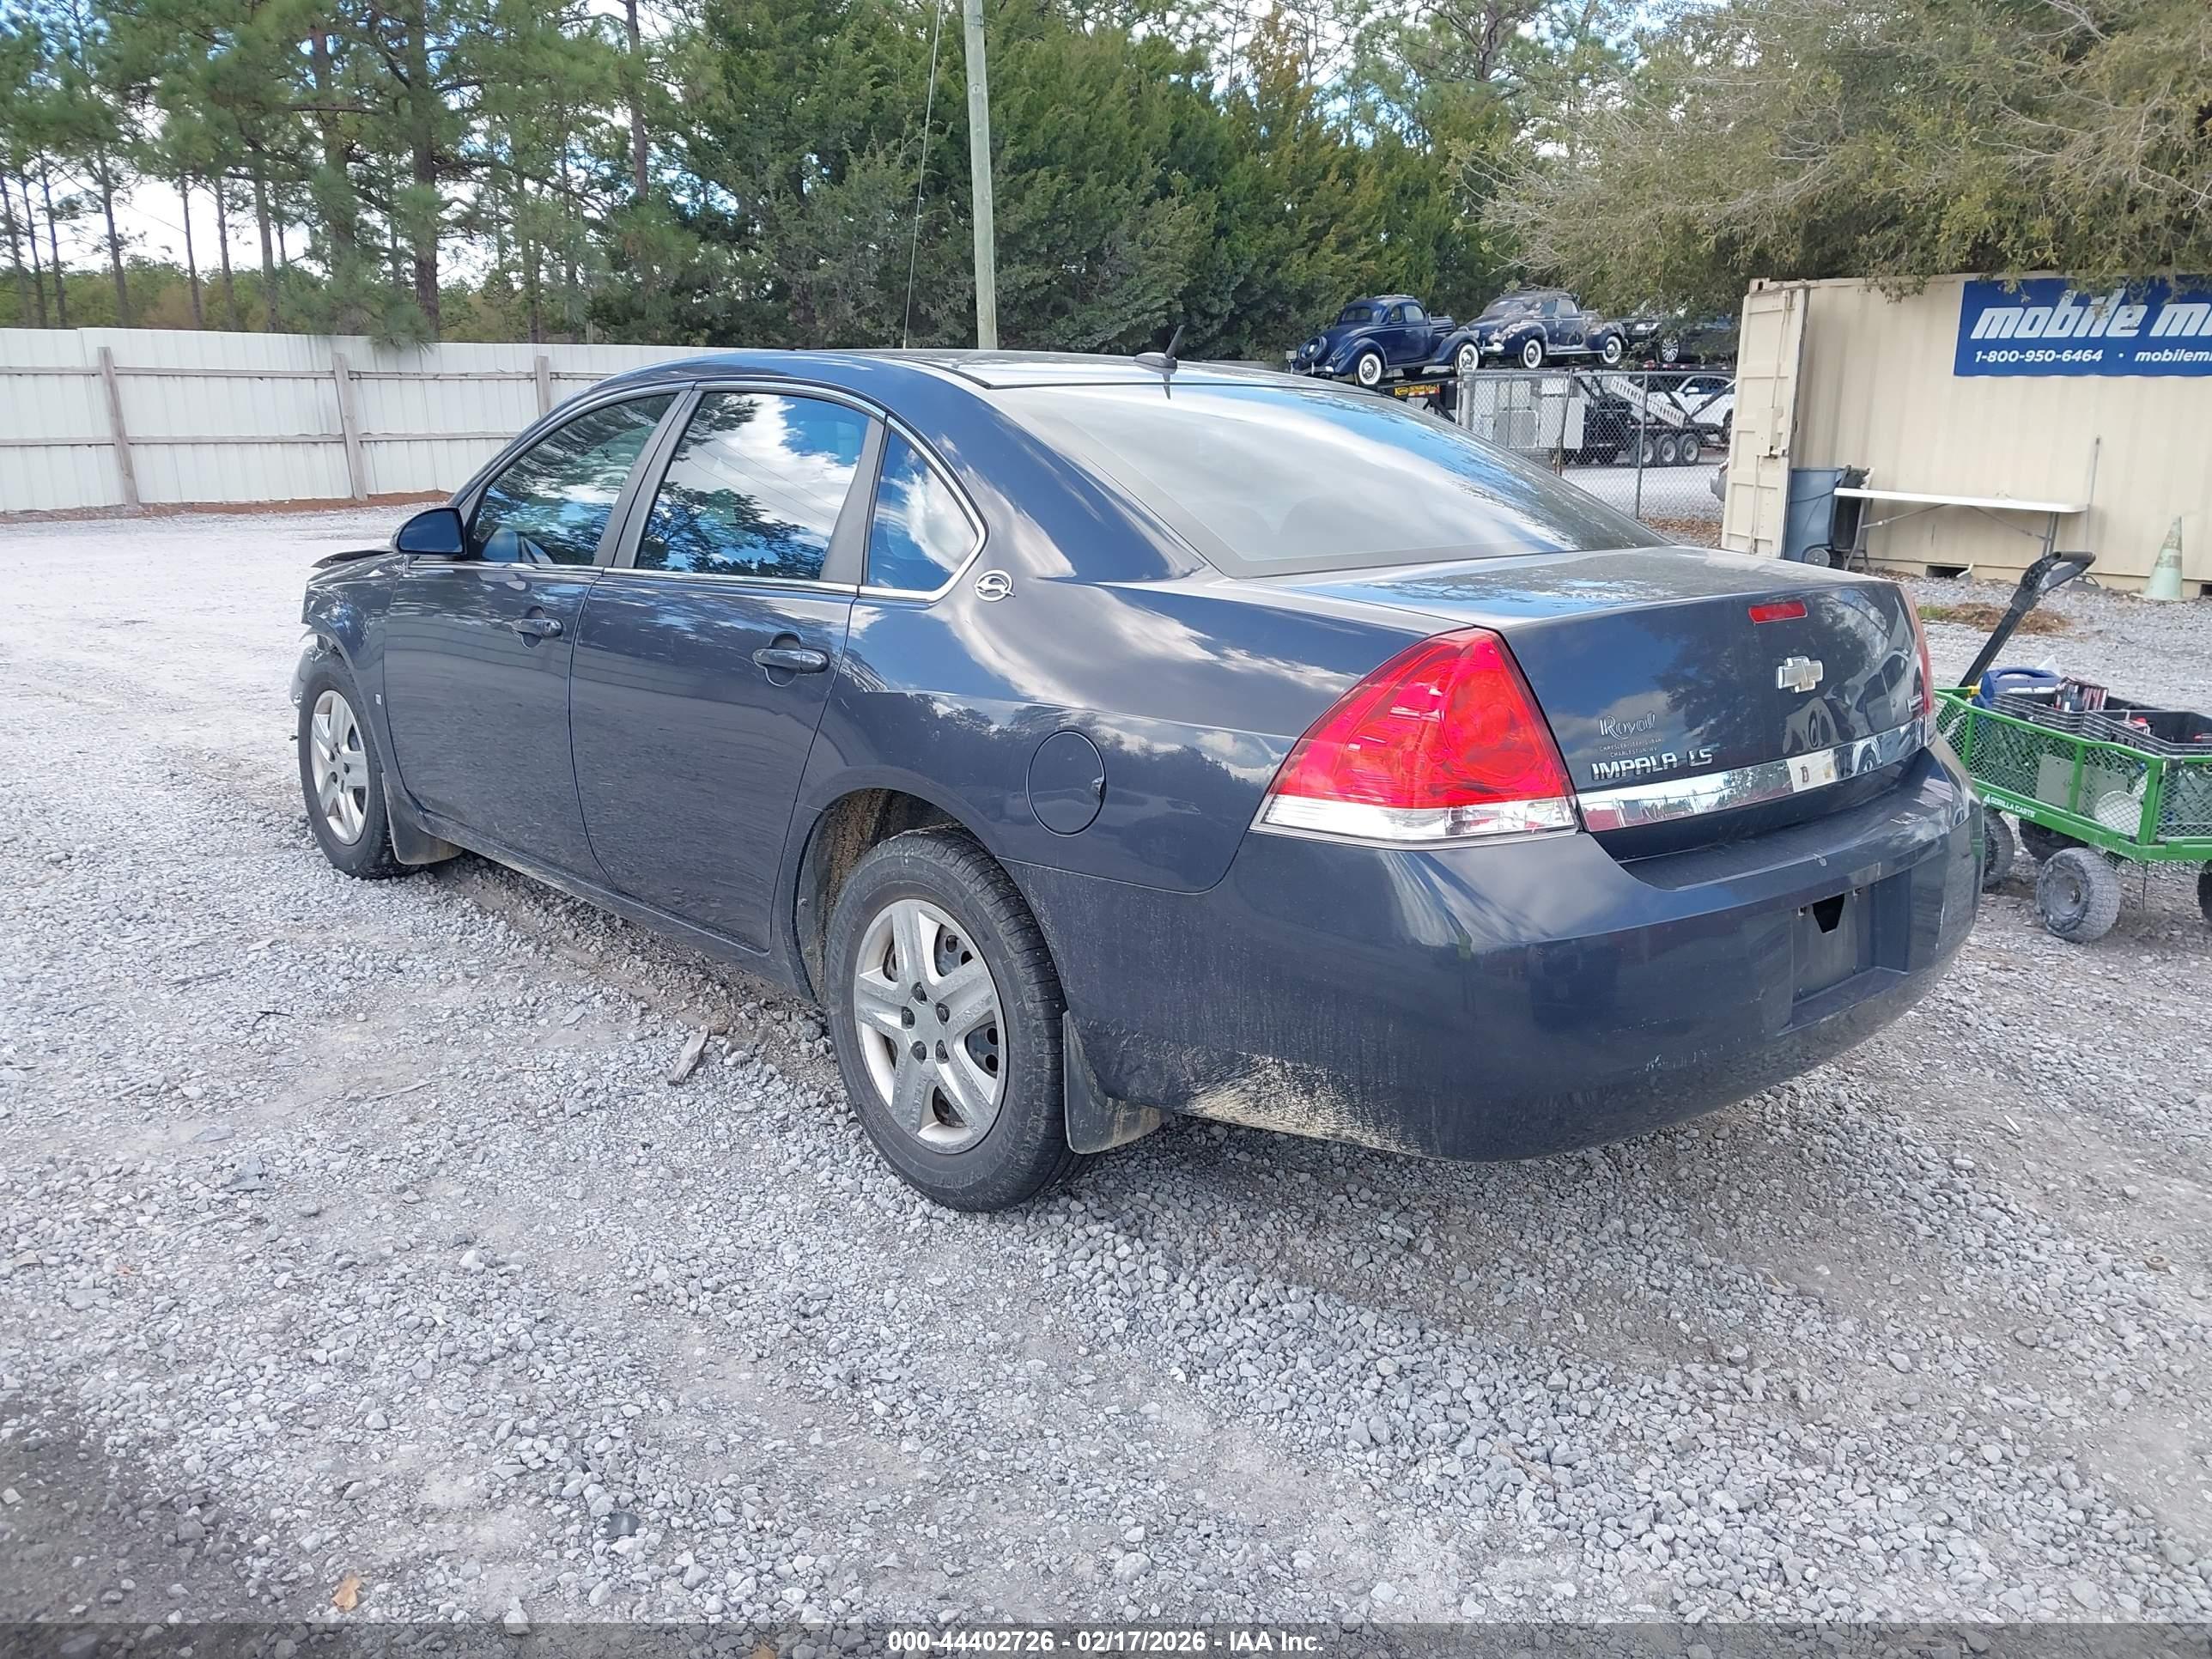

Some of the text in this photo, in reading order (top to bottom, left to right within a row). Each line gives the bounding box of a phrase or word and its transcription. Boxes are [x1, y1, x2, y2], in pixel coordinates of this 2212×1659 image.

[1970, 288, 2148, 339] mobile
[1975, 349, 2104, 363] 1-800-950-6464
[1599, 713, 1656, 740] Royal
[1592, 748, 1713, 781] IMPALA LS
[1990, 796, 2014, 811] GORILLA
